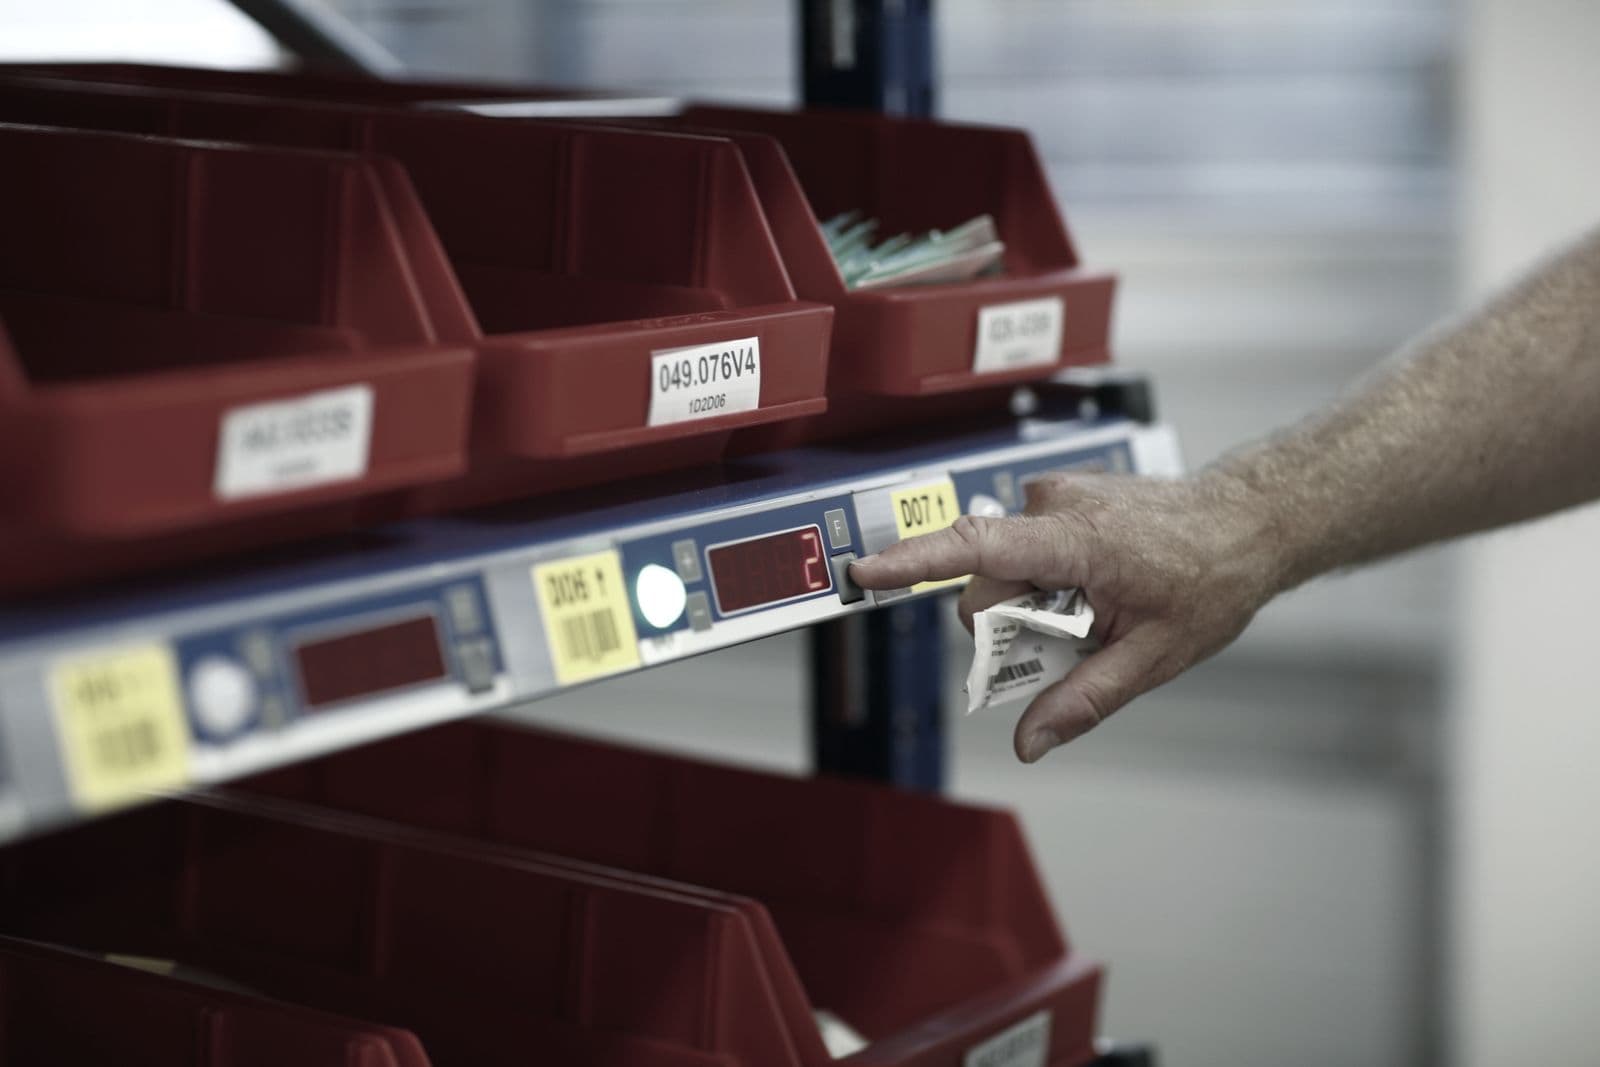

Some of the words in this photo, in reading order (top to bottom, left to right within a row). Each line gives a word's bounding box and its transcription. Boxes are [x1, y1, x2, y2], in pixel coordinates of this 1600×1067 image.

[659, 347, 756, 392] 049.076V4
[688, 393, 726, 414] 1D2D06
[833, 519, 841, 537] F
[900, 495, 930, 528] D07
[801, 532, 822, 589] 2
